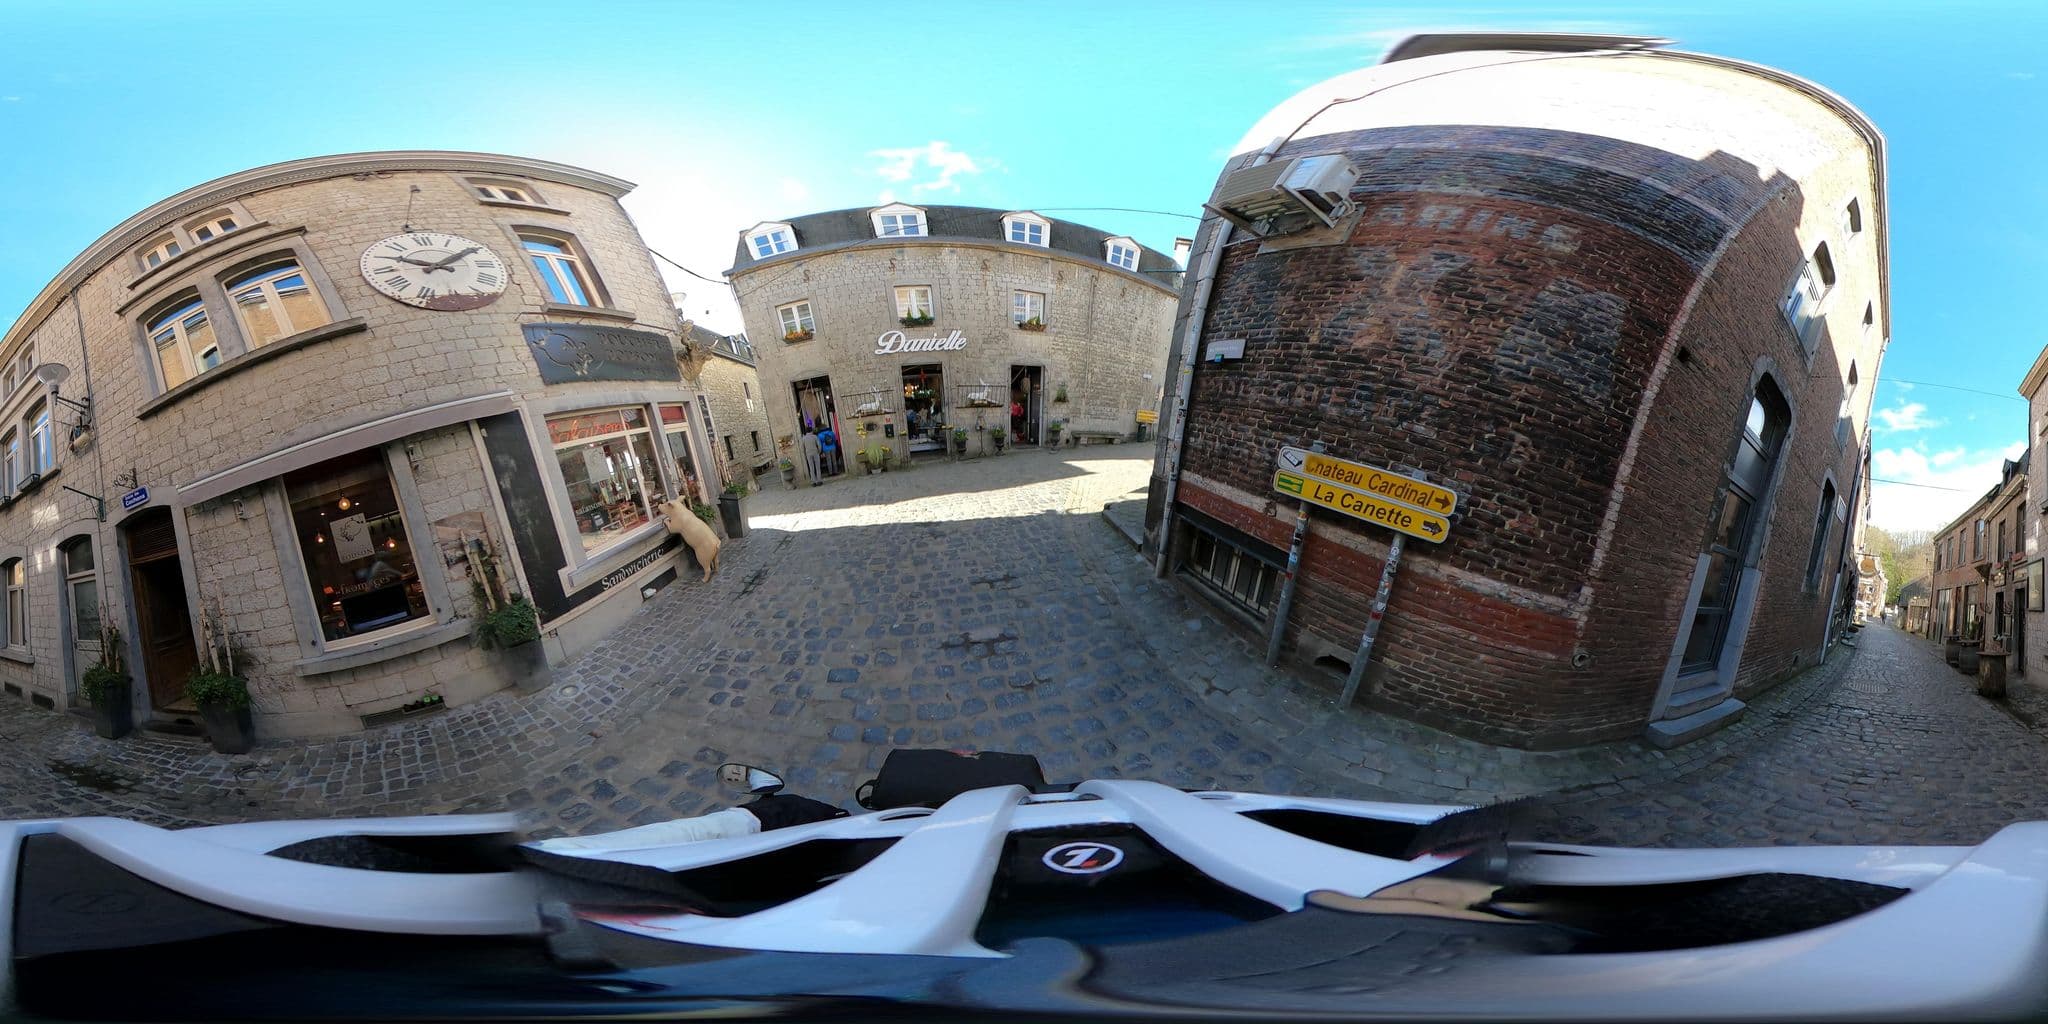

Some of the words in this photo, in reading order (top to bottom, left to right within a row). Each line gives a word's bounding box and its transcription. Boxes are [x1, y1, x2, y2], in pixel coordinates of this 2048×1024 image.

[874, 330, 967, 355] Danielle
[1313, 484, 1334, 502] La
[1340, 492, 1412, 528] Canette
[1368, 473, 1435, 507] Cardinal
